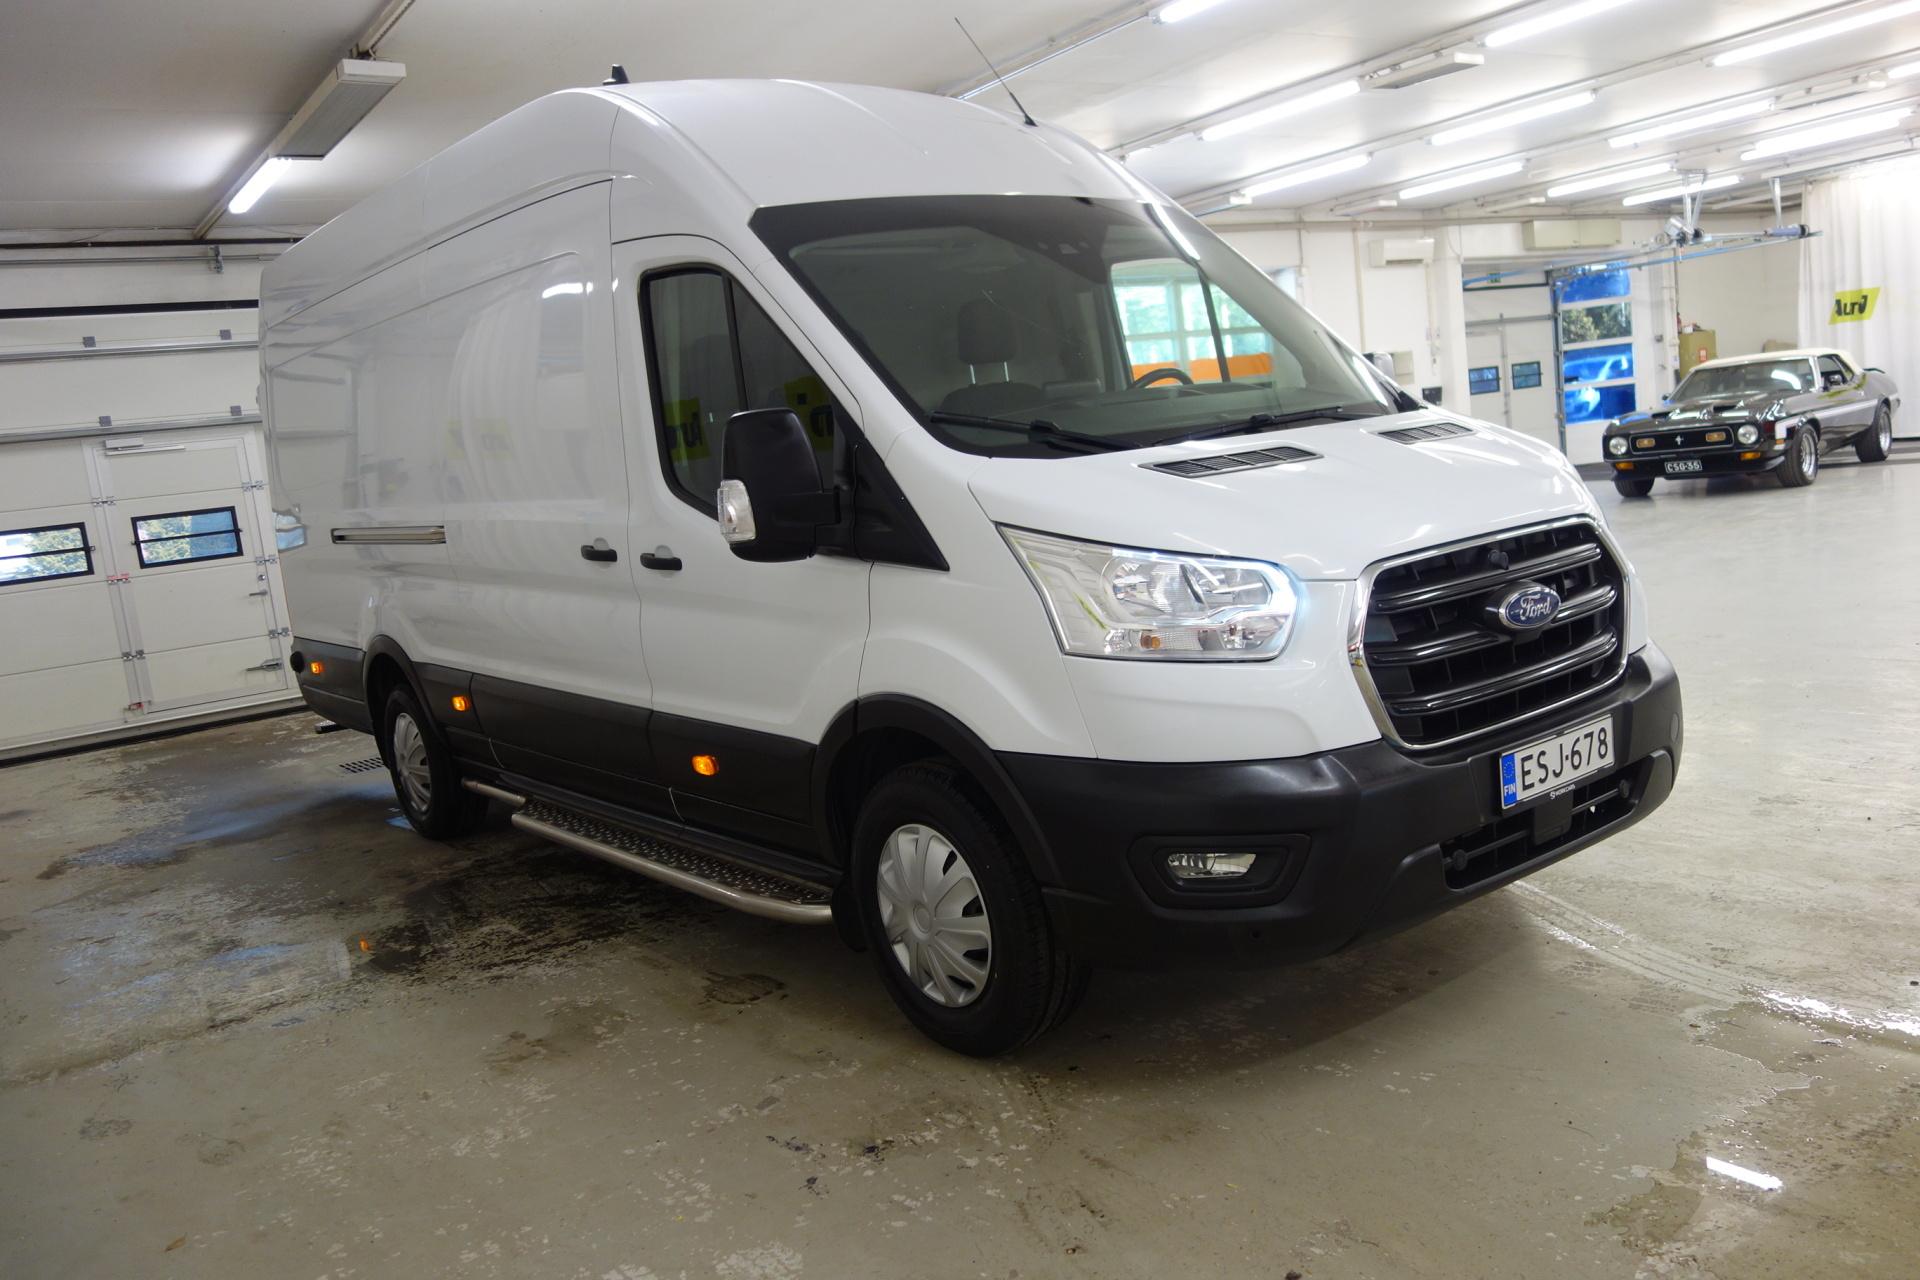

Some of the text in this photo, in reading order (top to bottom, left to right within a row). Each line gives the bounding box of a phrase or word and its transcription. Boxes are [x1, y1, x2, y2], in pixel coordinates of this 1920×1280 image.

[1519, 593, 1551, 621] Ford
[1520, 726, 1608, 792] ESJ-678
[1503, 782, 1516, 797] FIN
